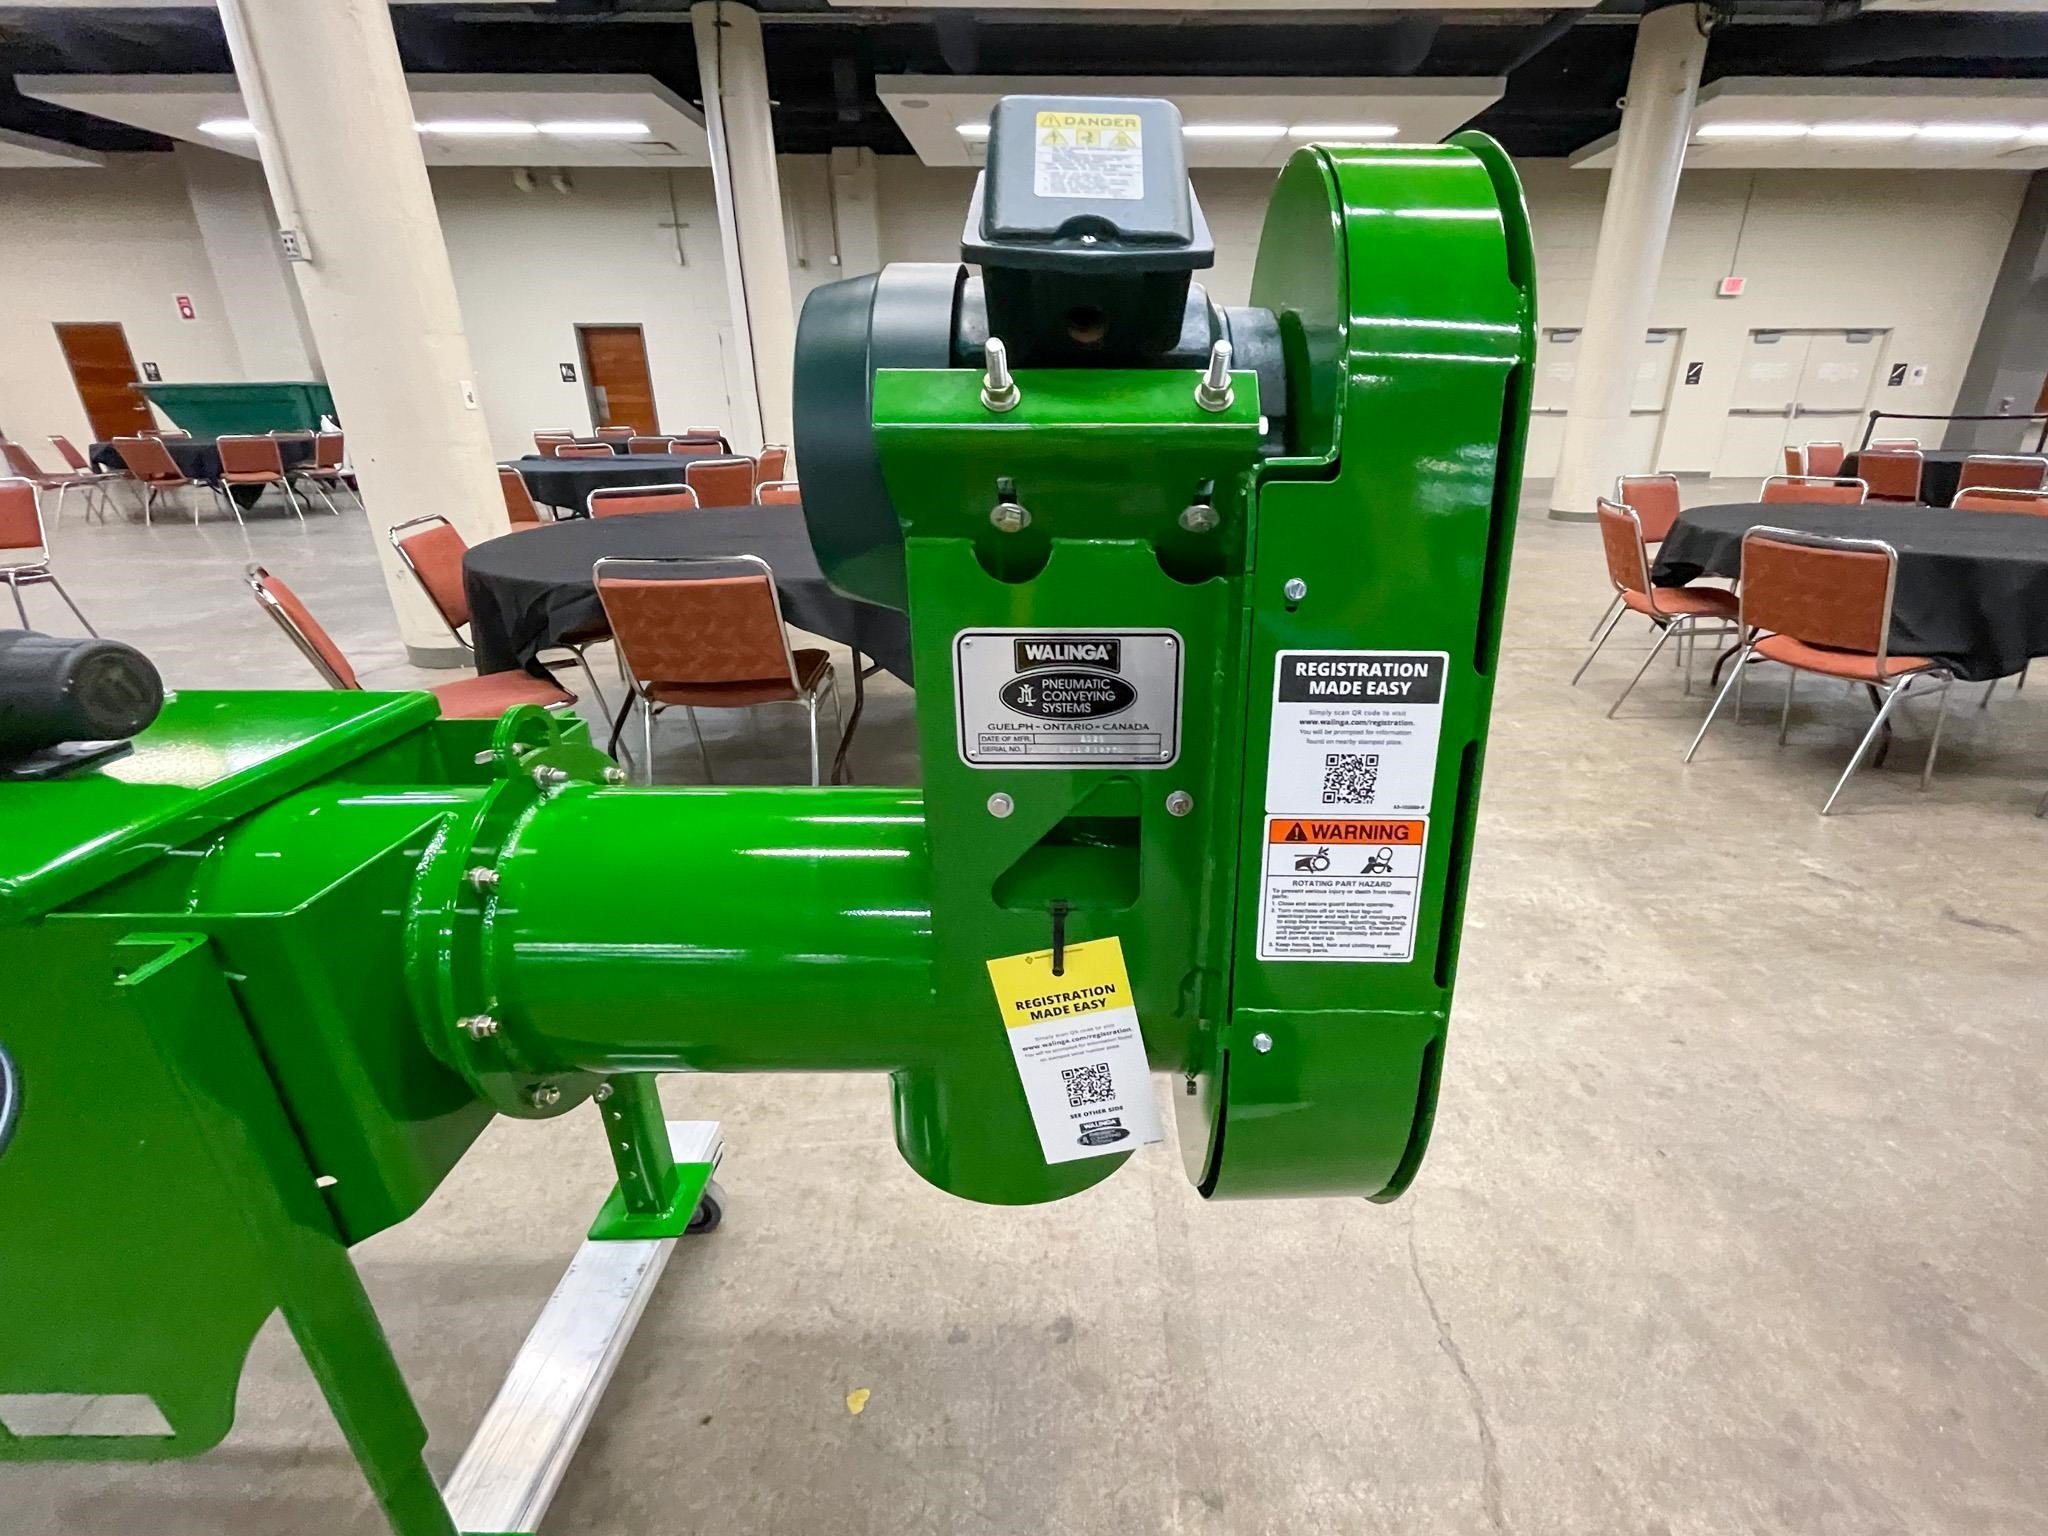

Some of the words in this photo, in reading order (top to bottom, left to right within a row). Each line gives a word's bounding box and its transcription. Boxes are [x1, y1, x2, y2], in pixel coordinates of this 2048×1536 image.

[1064, 116, 1137, 127] DANGER
[1024, 644, 1109, 661] WALINGA
[1295, 662, 1429, 677] REGISTRATION
[1041, 679, 1111, 690] PNEUMATIC
[1309, 681, 1362, 695] MADE
[1366, 681, 1412, 695] EASY
[1042, 691, 1116, 702] CONVEYING
[1042, 702, 1091, 713] SYSTEMS
[1042, 723, 1093, 731] ONTARIO
[1102, 723, 1150, 731] CANADA
[1311, 824, 1409, 840] WARNING
[1015, 983, 1116, 1011] REGISTRATION
[1030, 1005, 1070, 1021] MADE
[1074, 998, 1107, 1012] EASY
[1083, 1109, 1107, 1117] OTHER
[1108, 1105, 1124, 1113] SIDE
